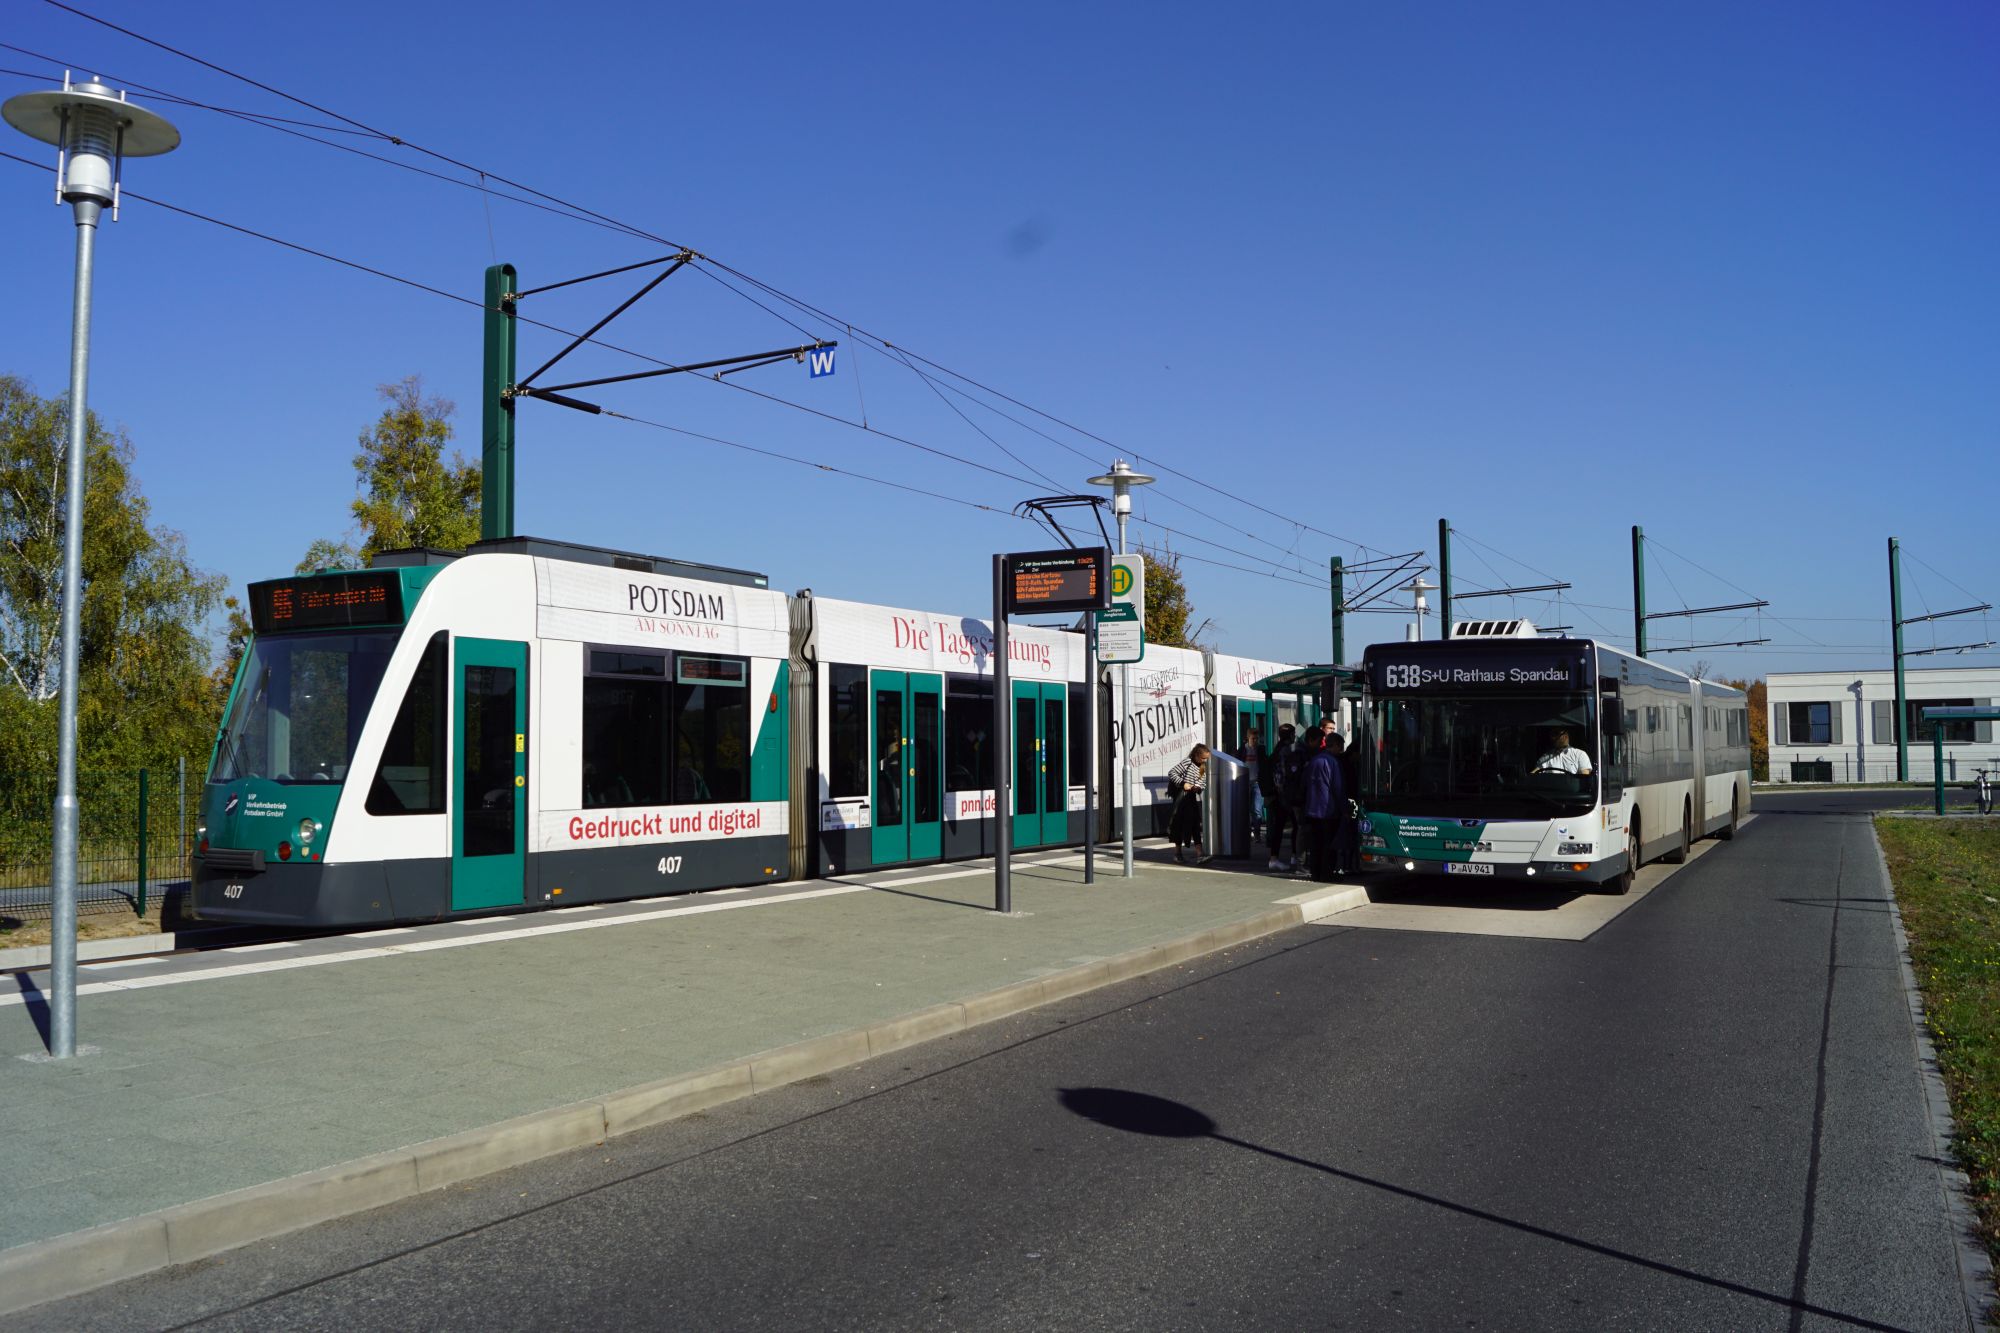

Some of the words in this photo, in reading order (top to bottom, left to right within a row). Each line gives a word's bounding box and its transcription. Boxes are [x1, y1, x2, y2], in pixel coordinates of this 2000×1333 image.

[811, 350, 835, 375] W
[628, 583, 724, 621] POTSDAM
[634, 617, 656, 633] AM
[659, 621, 719, 640] SONNTAG
[892, 616, 929, 651] Die
[1386, 664, 1421, 688] 638
[1421, 669, 1450, 683] S+U
[1453, 668, 1506, 683] Rathaus
[1510, 667, 1569, 684] Spandau
[244, 809, 266, 817] Potsdam
[246, 802, 287, 810] Verkehrsbetrieb
[568, 813, 662, 841] Gedruckt
[669, 811, 702, 834] und
[708, 808, 761, 836] digital
[1399, 824, 1439, 832] Verkehrsbetrieb
[657, 856, 683, 874] 407
[1451, 864, 1457, 872] P
[1461, 865, 1473, 873] AV
[1474, 865, 1490, 874] 941
[224, 885, 244, 899] 407
